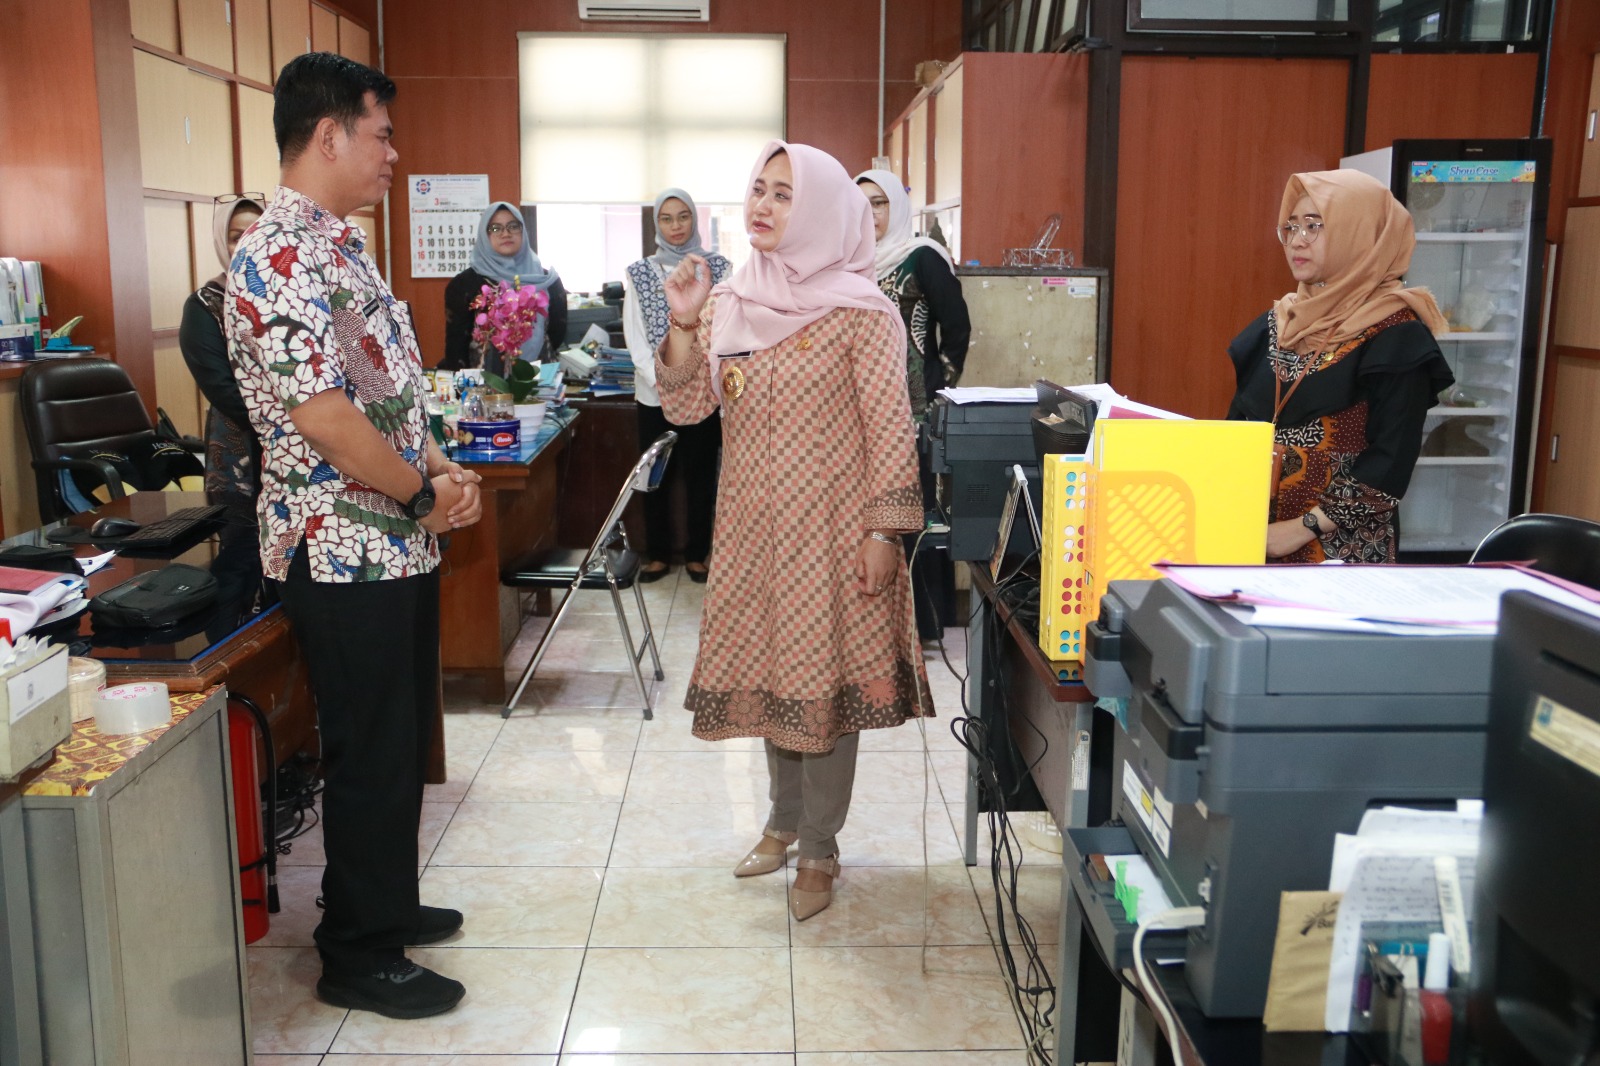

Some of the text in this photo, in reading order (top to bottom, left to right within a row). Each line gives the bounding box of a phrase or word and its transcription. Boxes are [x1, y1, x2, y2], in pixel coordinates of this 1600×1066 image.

[434, 198, 440, 206] 3
[418, 226, 423, 234] 2
[428, 225, 433, 234] 3
[438, 225, 443, 234] 4
[448, 225, 453, 234] 5
[458, 225, 464, 234] 6
[418, 239, 424, 247] 9
[427, 238, 435, 247] 10
[438, 238, 445, 247] 11
[448, 238, 455, 247] 12
[458, 238, 466, 247] 13
[417, 250, 466, 260] 16 17 18 19 20
[438, 263, 446, 272] 25
[448, 263, 457, 272] 26
